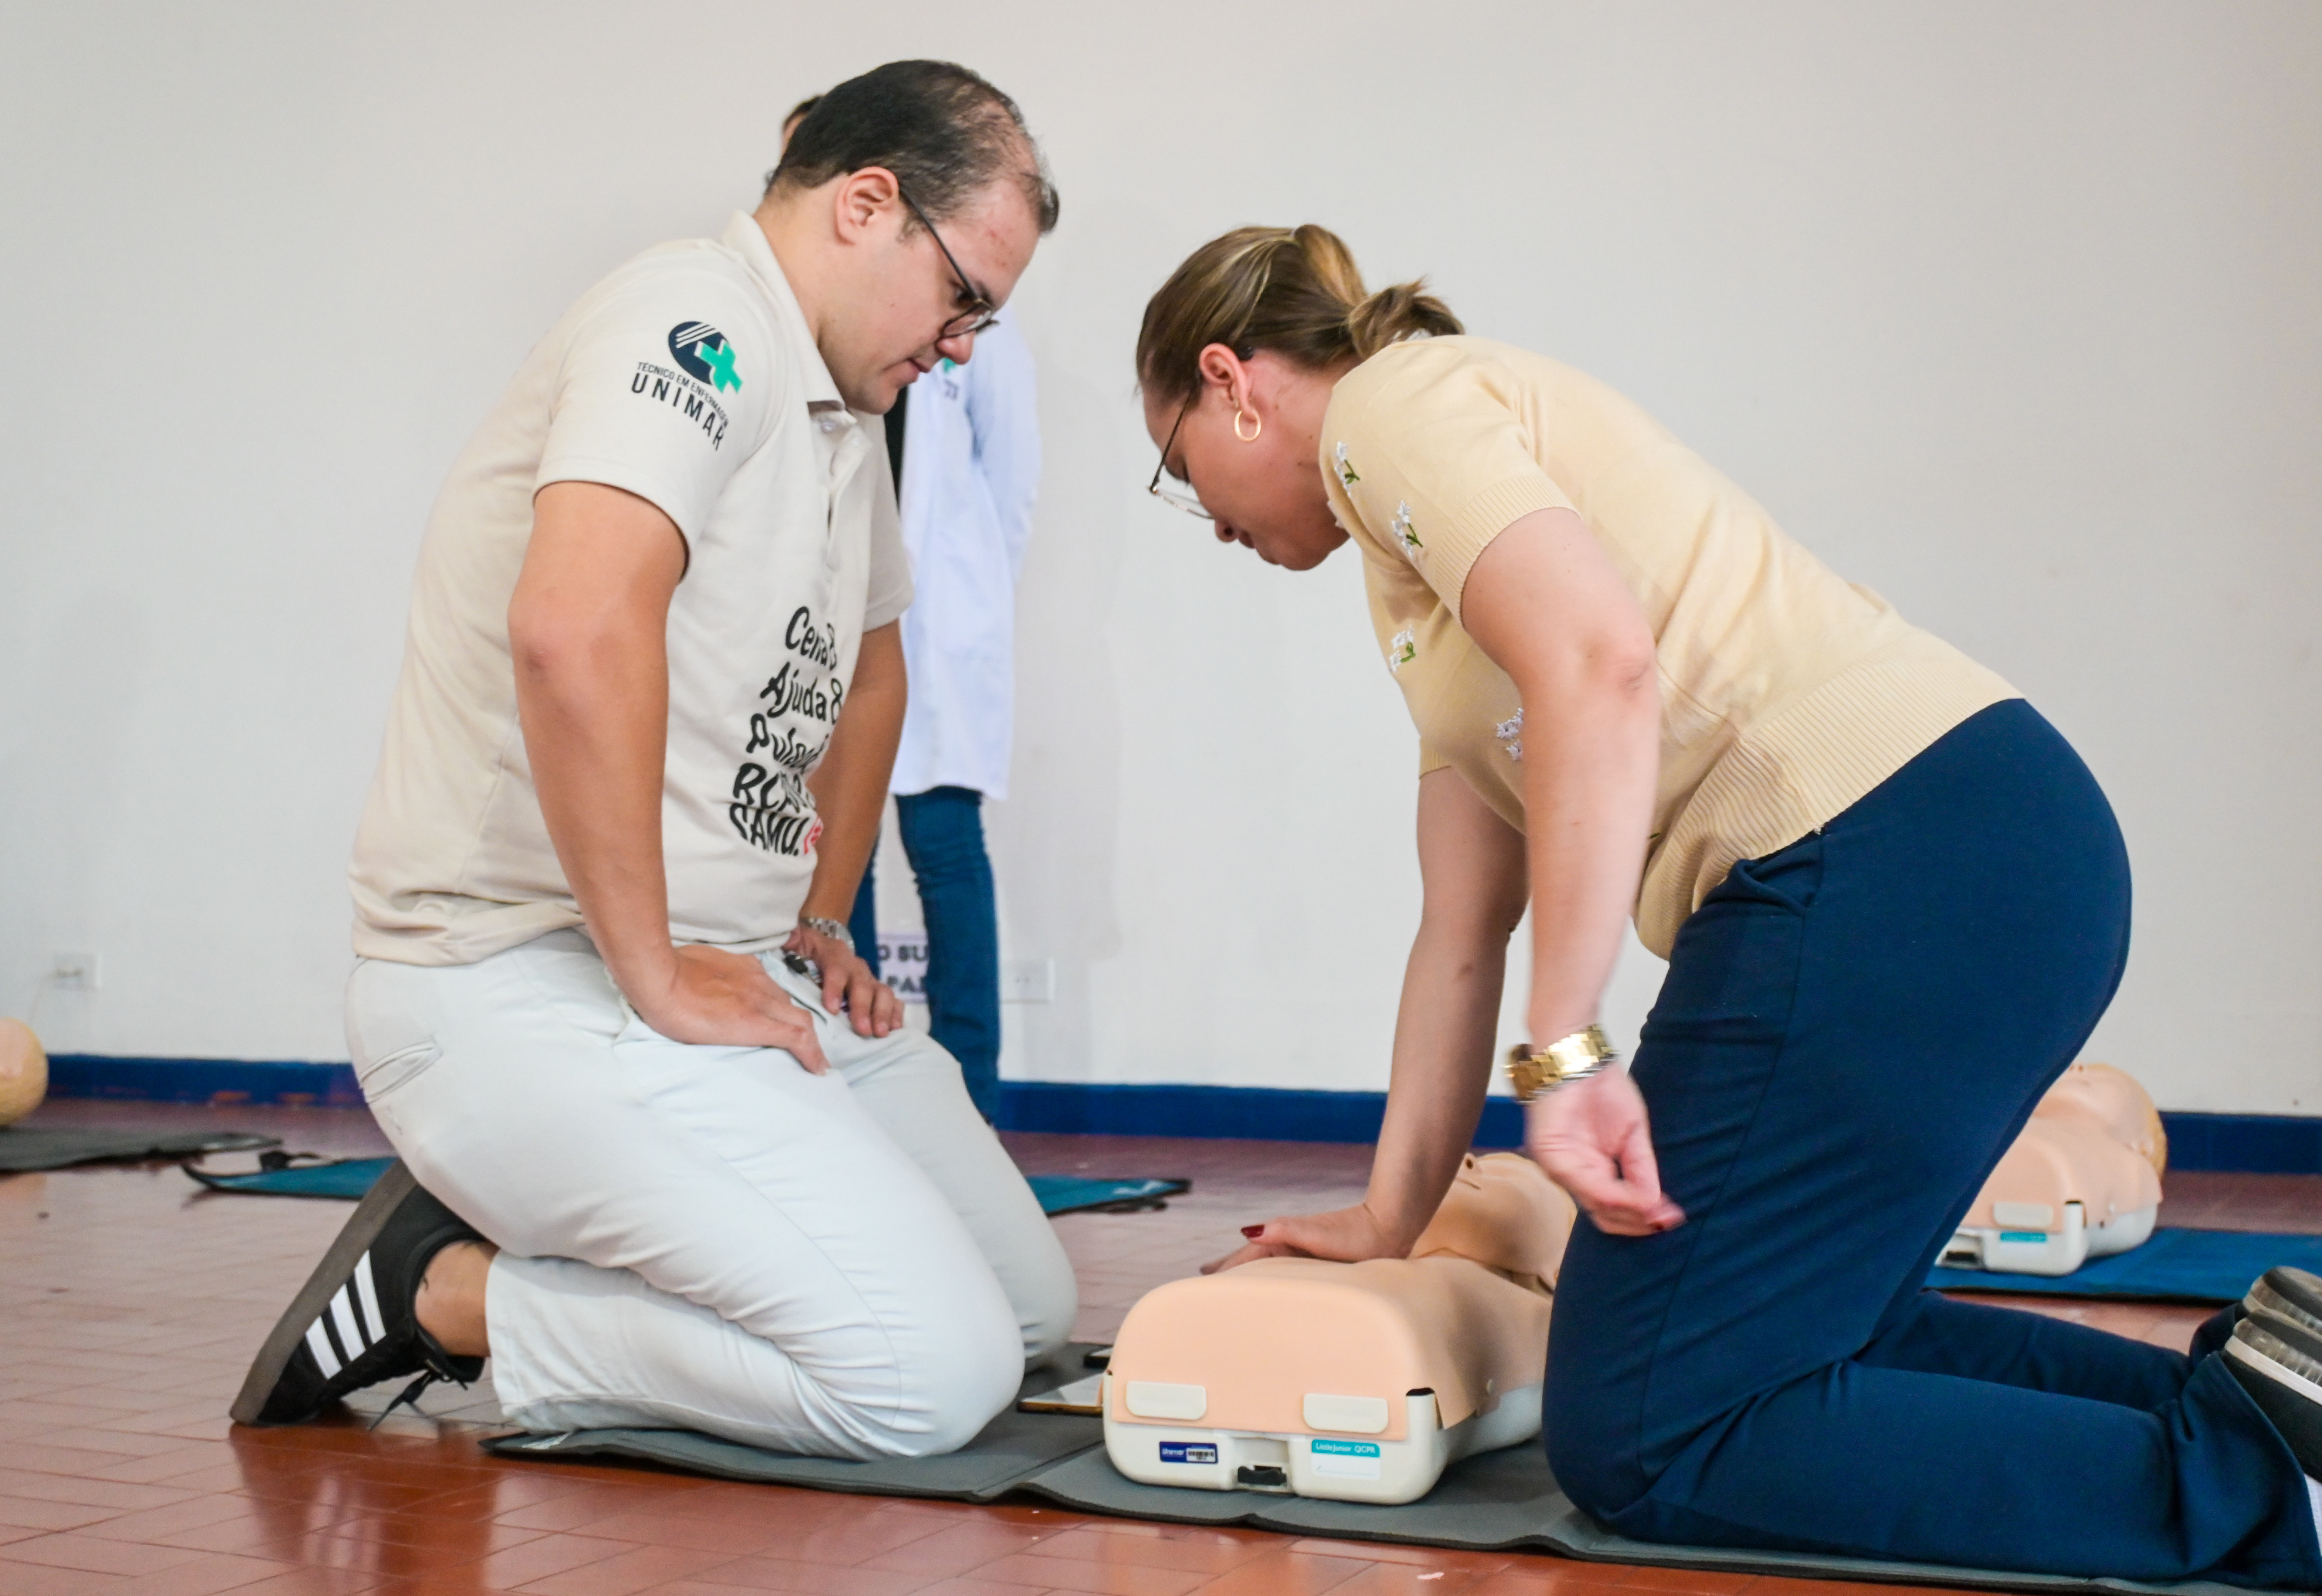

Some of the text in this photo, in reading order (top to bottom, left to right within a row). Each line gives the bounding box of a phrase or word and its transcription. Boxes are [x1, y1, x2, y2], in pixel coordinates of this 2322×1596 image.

[638, 362, 675, 380] TÉCNICO
[677, 374, 689, 387] EM
[631, 372, 724, 451] UNIMAR
